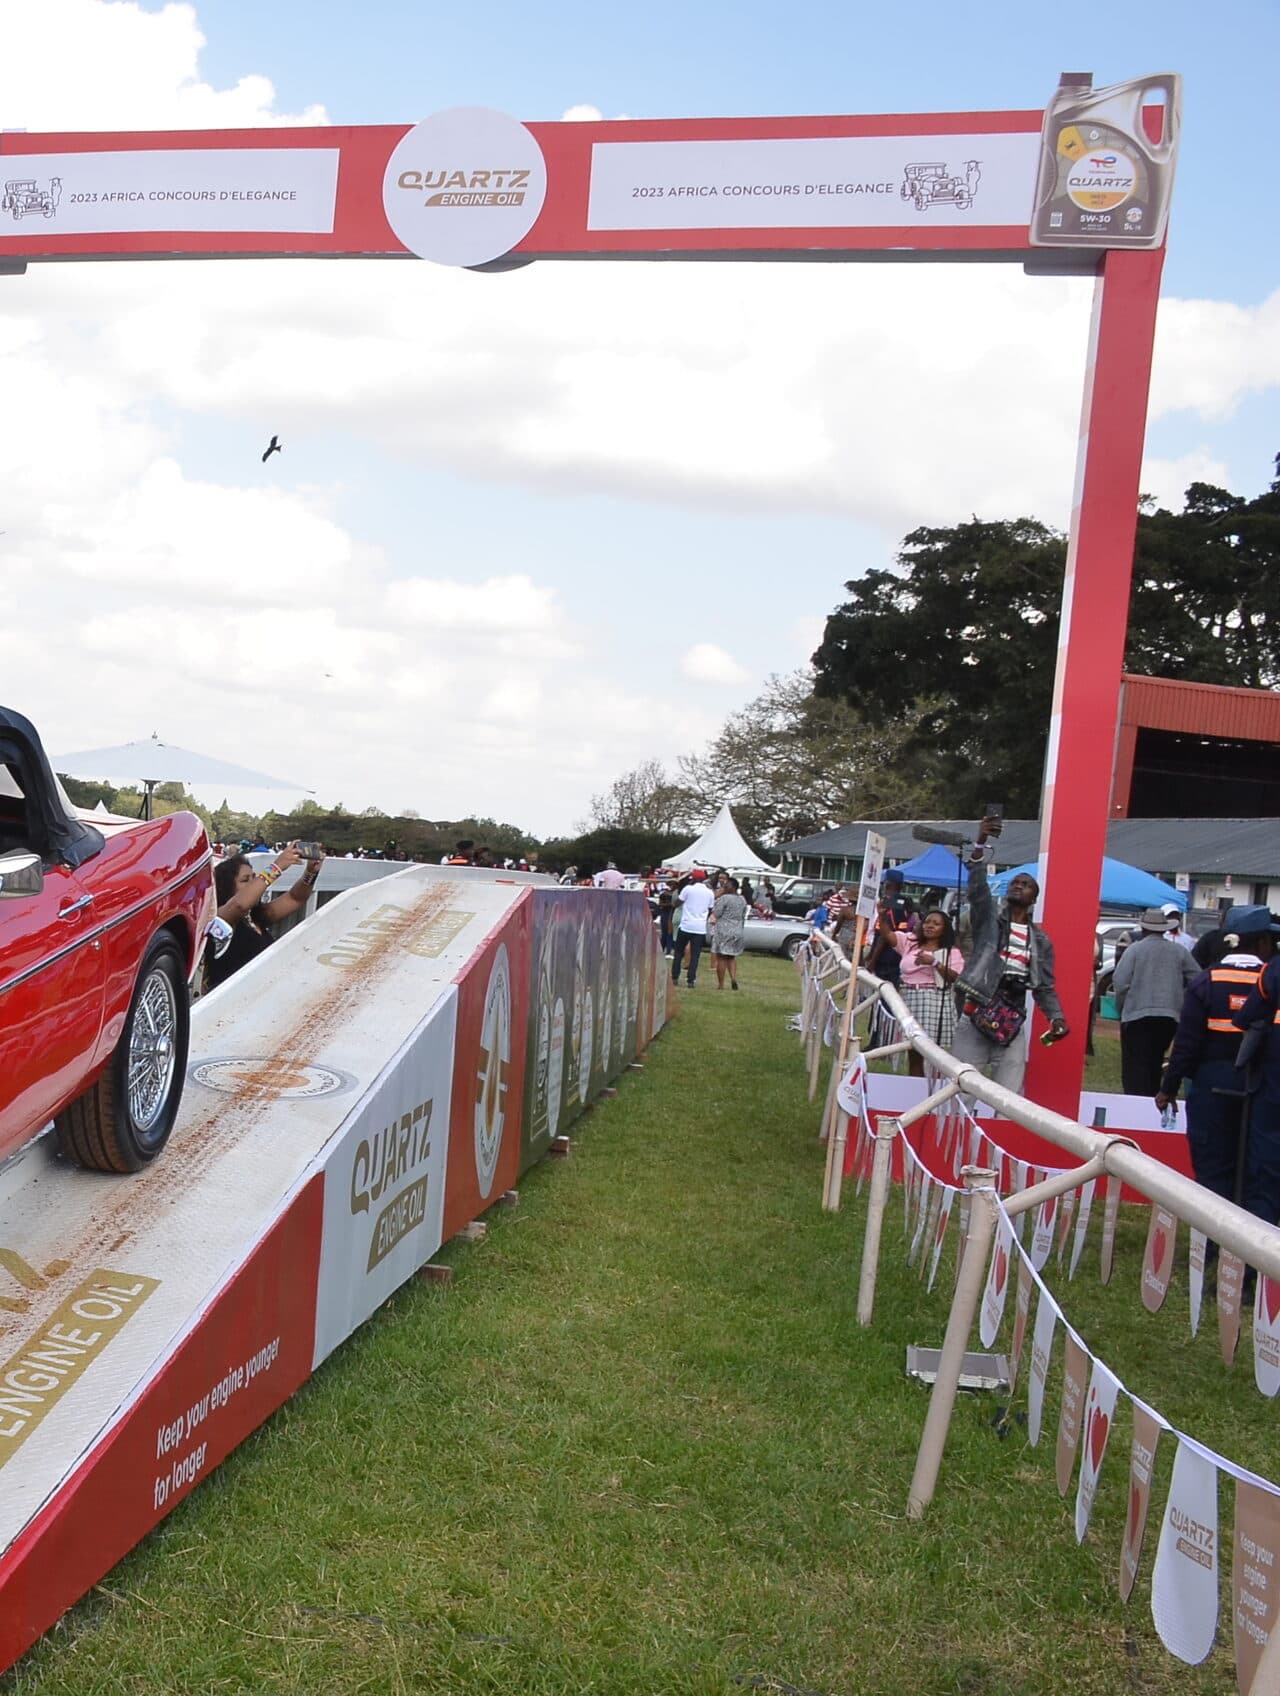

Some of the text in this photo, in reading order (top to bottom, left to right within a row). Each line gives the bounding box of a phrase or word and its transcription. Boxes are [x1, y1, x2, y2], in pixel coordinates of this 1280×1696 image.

[398, 170, 531, 191] QUARTZ
[632, 183, 894, 198] 2023 AFRICA CONCOURS D'ELEGANCE
[1069, 177, 1132, 187] QUARTZ
[70, 190, 297, 203] 2023 AFRICA CONCOURS D'ELEGANCE
[440, 194, 520, 205] ENGINE OIL
[1080, 215, 1111, 223] 5W-30
[350, 1098, 433, 1216] QUARTZ
[377, 1183, 424, 1257] ENGINE OIL
[72, 1282, 144, 1320] OIL
[156, 1336, 281, 1460] Keep your engine younger
[153, 1441, 208, 1511] for longer
[1170, 1506, 1214, 1550] QUARTZ
